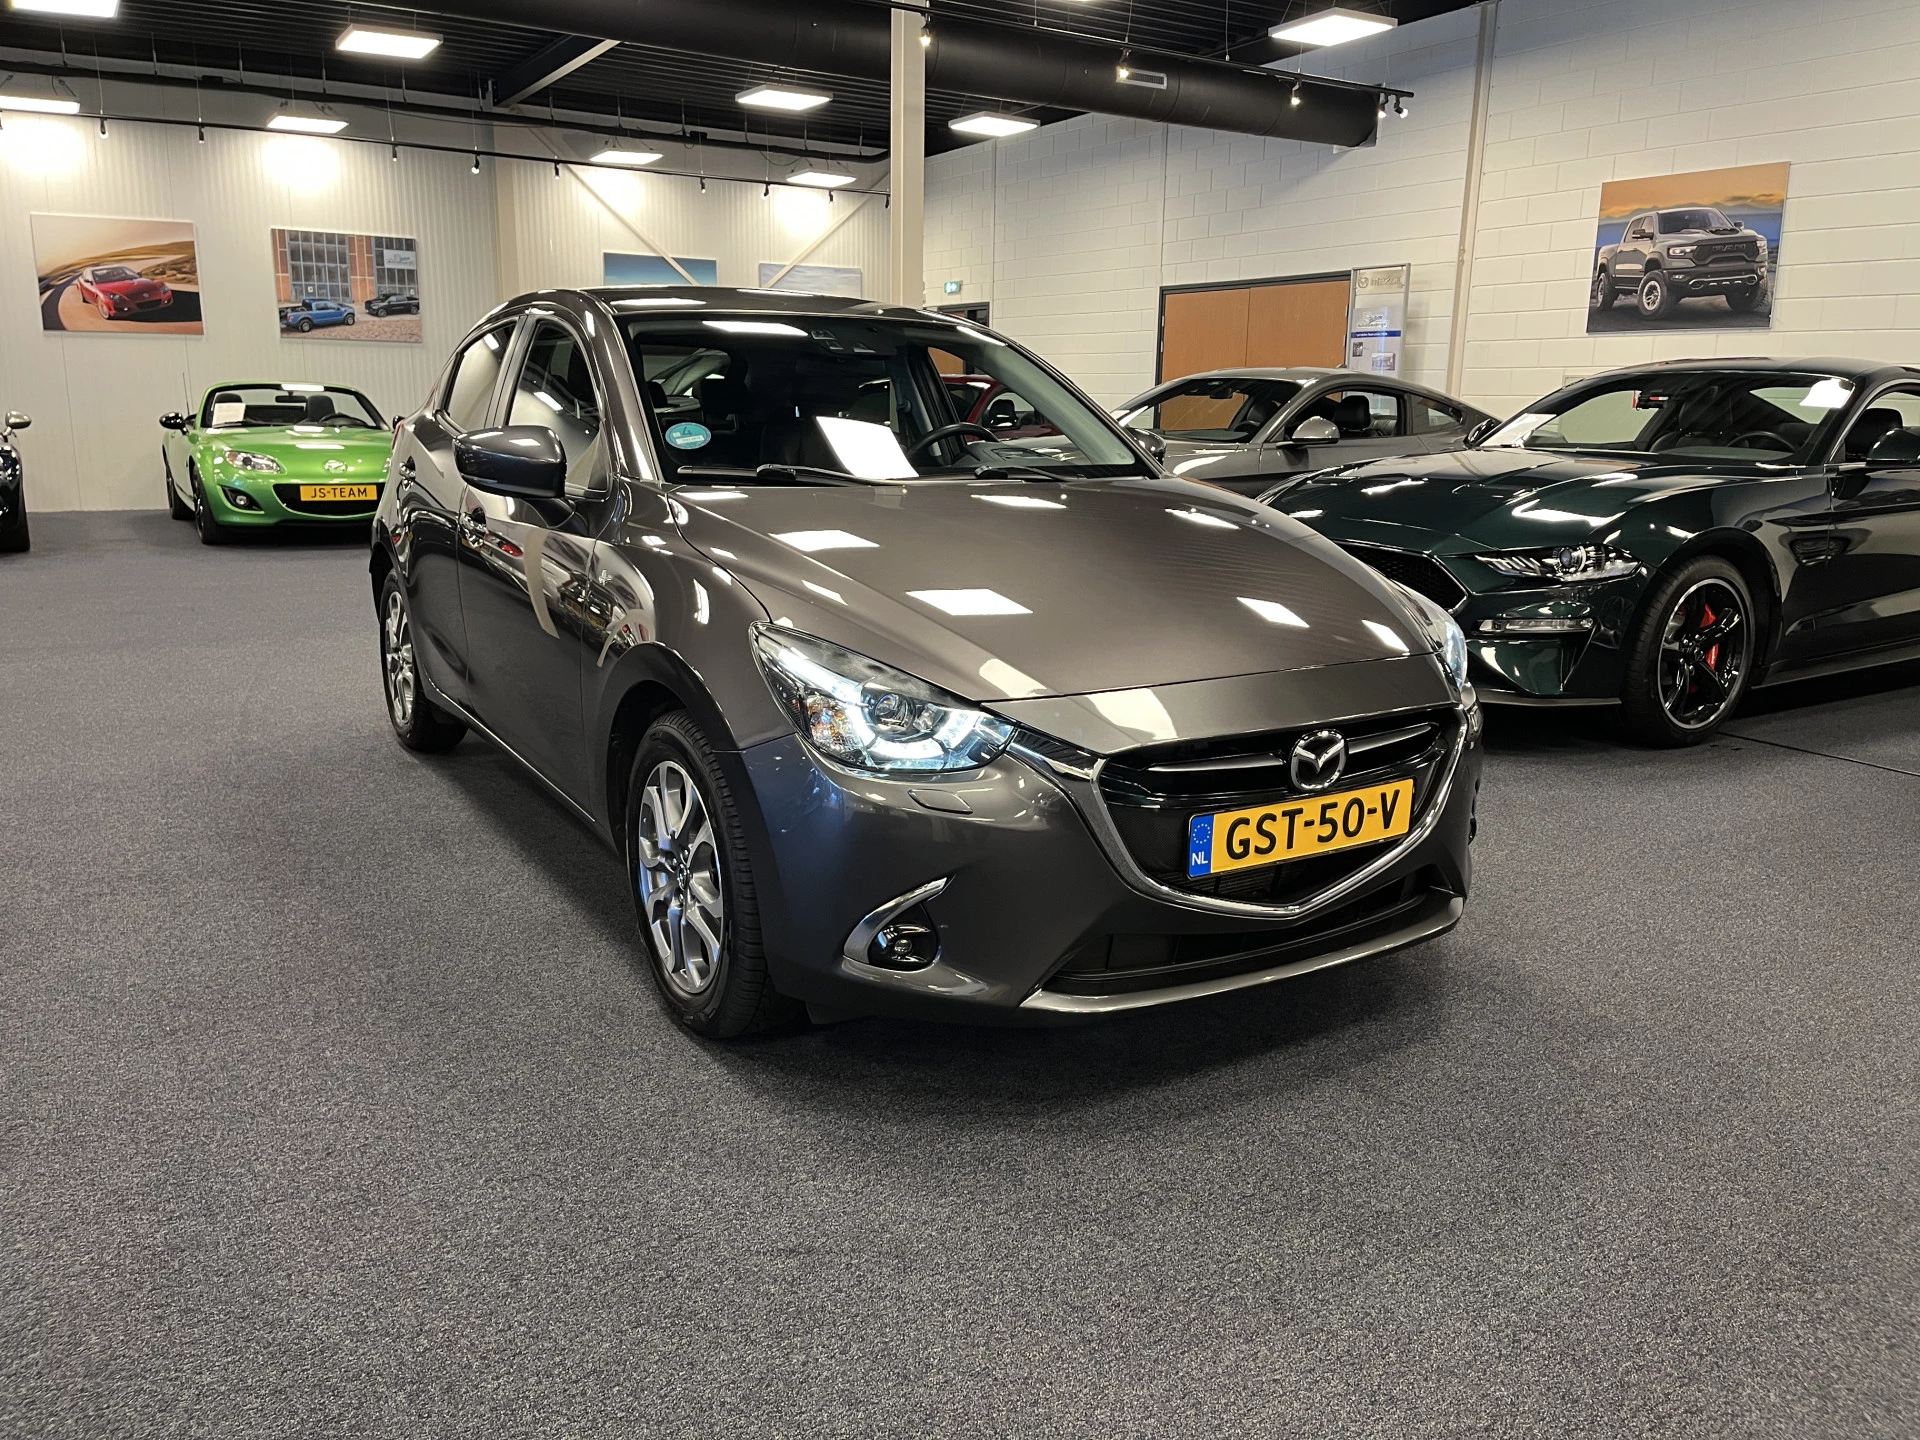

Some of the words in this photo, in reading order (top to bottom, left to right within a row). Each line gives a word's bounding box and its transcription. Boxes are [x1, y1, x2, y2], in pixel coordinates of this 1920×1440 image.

[682, 426, 692, 436] 4
[311, 487, 368, 499] JS-TEAM
[1226, 789, 1400, 860] GST-50-V
[1191, 851, 1208, 866] NL
